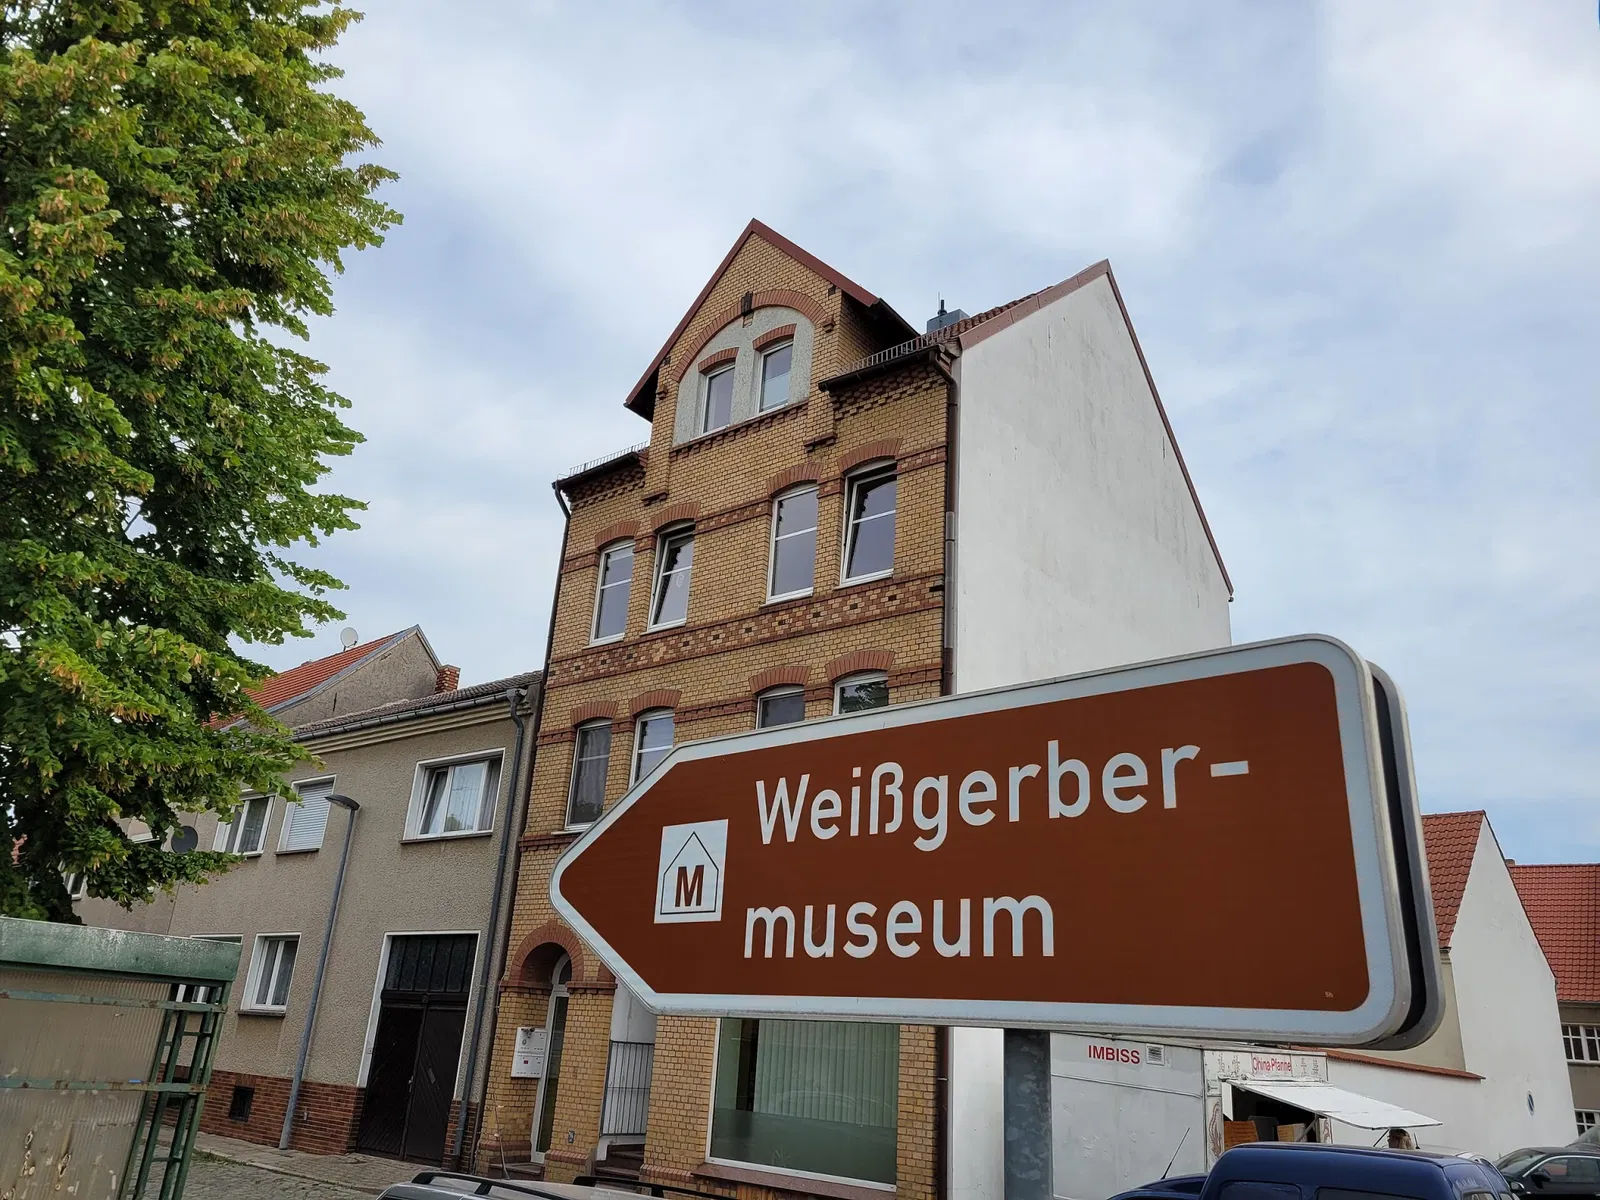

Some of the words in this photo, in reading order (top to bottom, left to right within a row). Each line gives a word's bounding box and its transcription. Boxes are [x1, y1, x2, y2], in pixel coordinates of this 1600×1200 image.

[756, 740, 1249, 852] Weißgerber-
[674, 864, 705, 908] M
[744, 895, 1054, 959] museum
[1088, 1045, 1141, 1064] IMBISS
